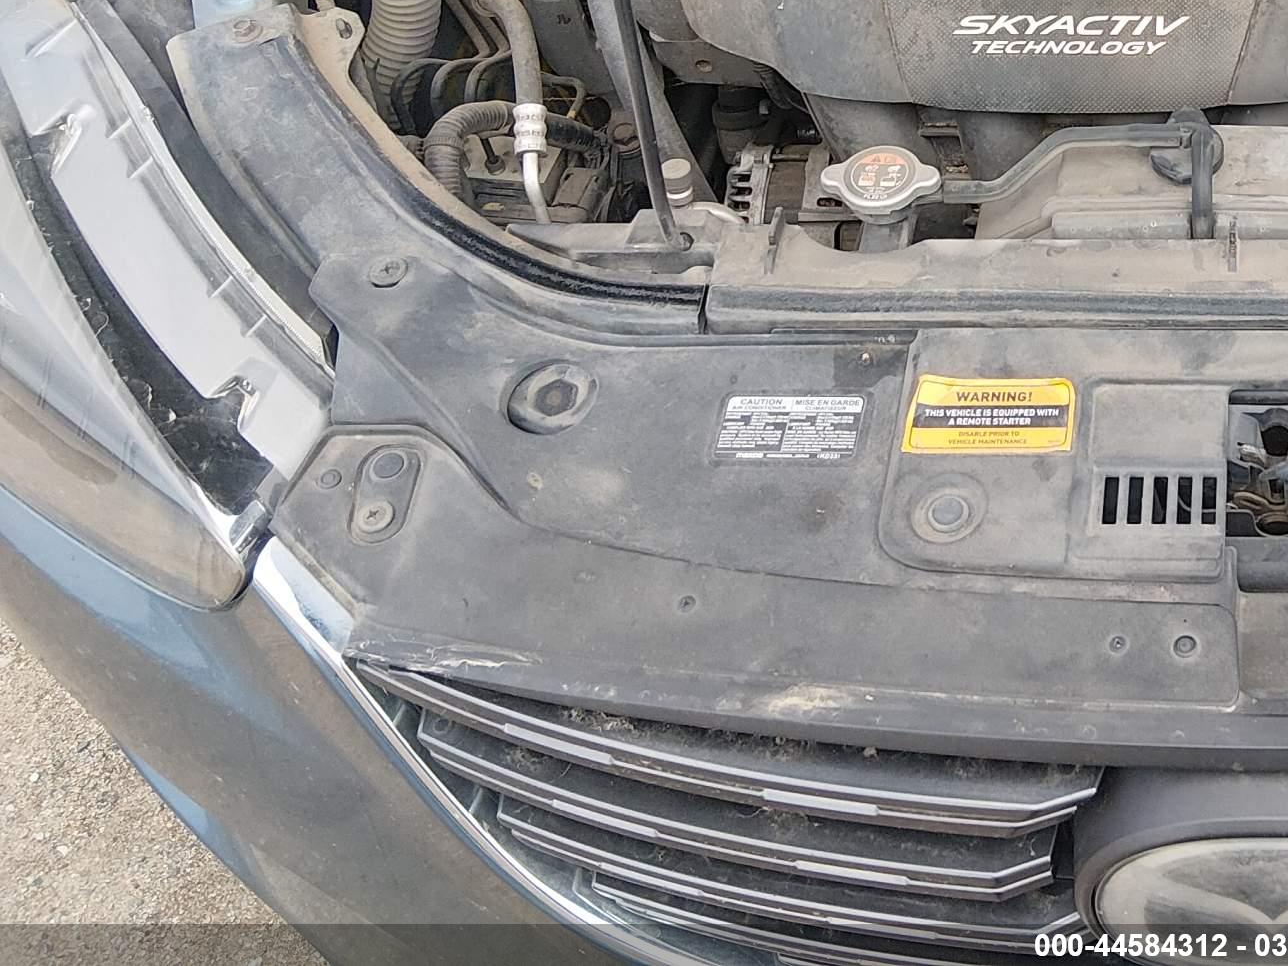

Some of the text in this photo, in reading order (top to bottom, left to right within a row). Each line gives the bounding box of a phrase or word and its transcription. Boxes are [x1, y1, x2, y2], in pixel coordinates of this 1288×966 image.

[952, 15, 1190, 36] SKYACTIV
[971, 40, 1167, 55] TECHNOLOGY
[955, 391, 1033, 403] WARNING!
[924, 408, 1059, 417] THIS VEHICLE IS EQUIPPED WITH
[948, 417, 1032, 426] A REMOTE STARTER
